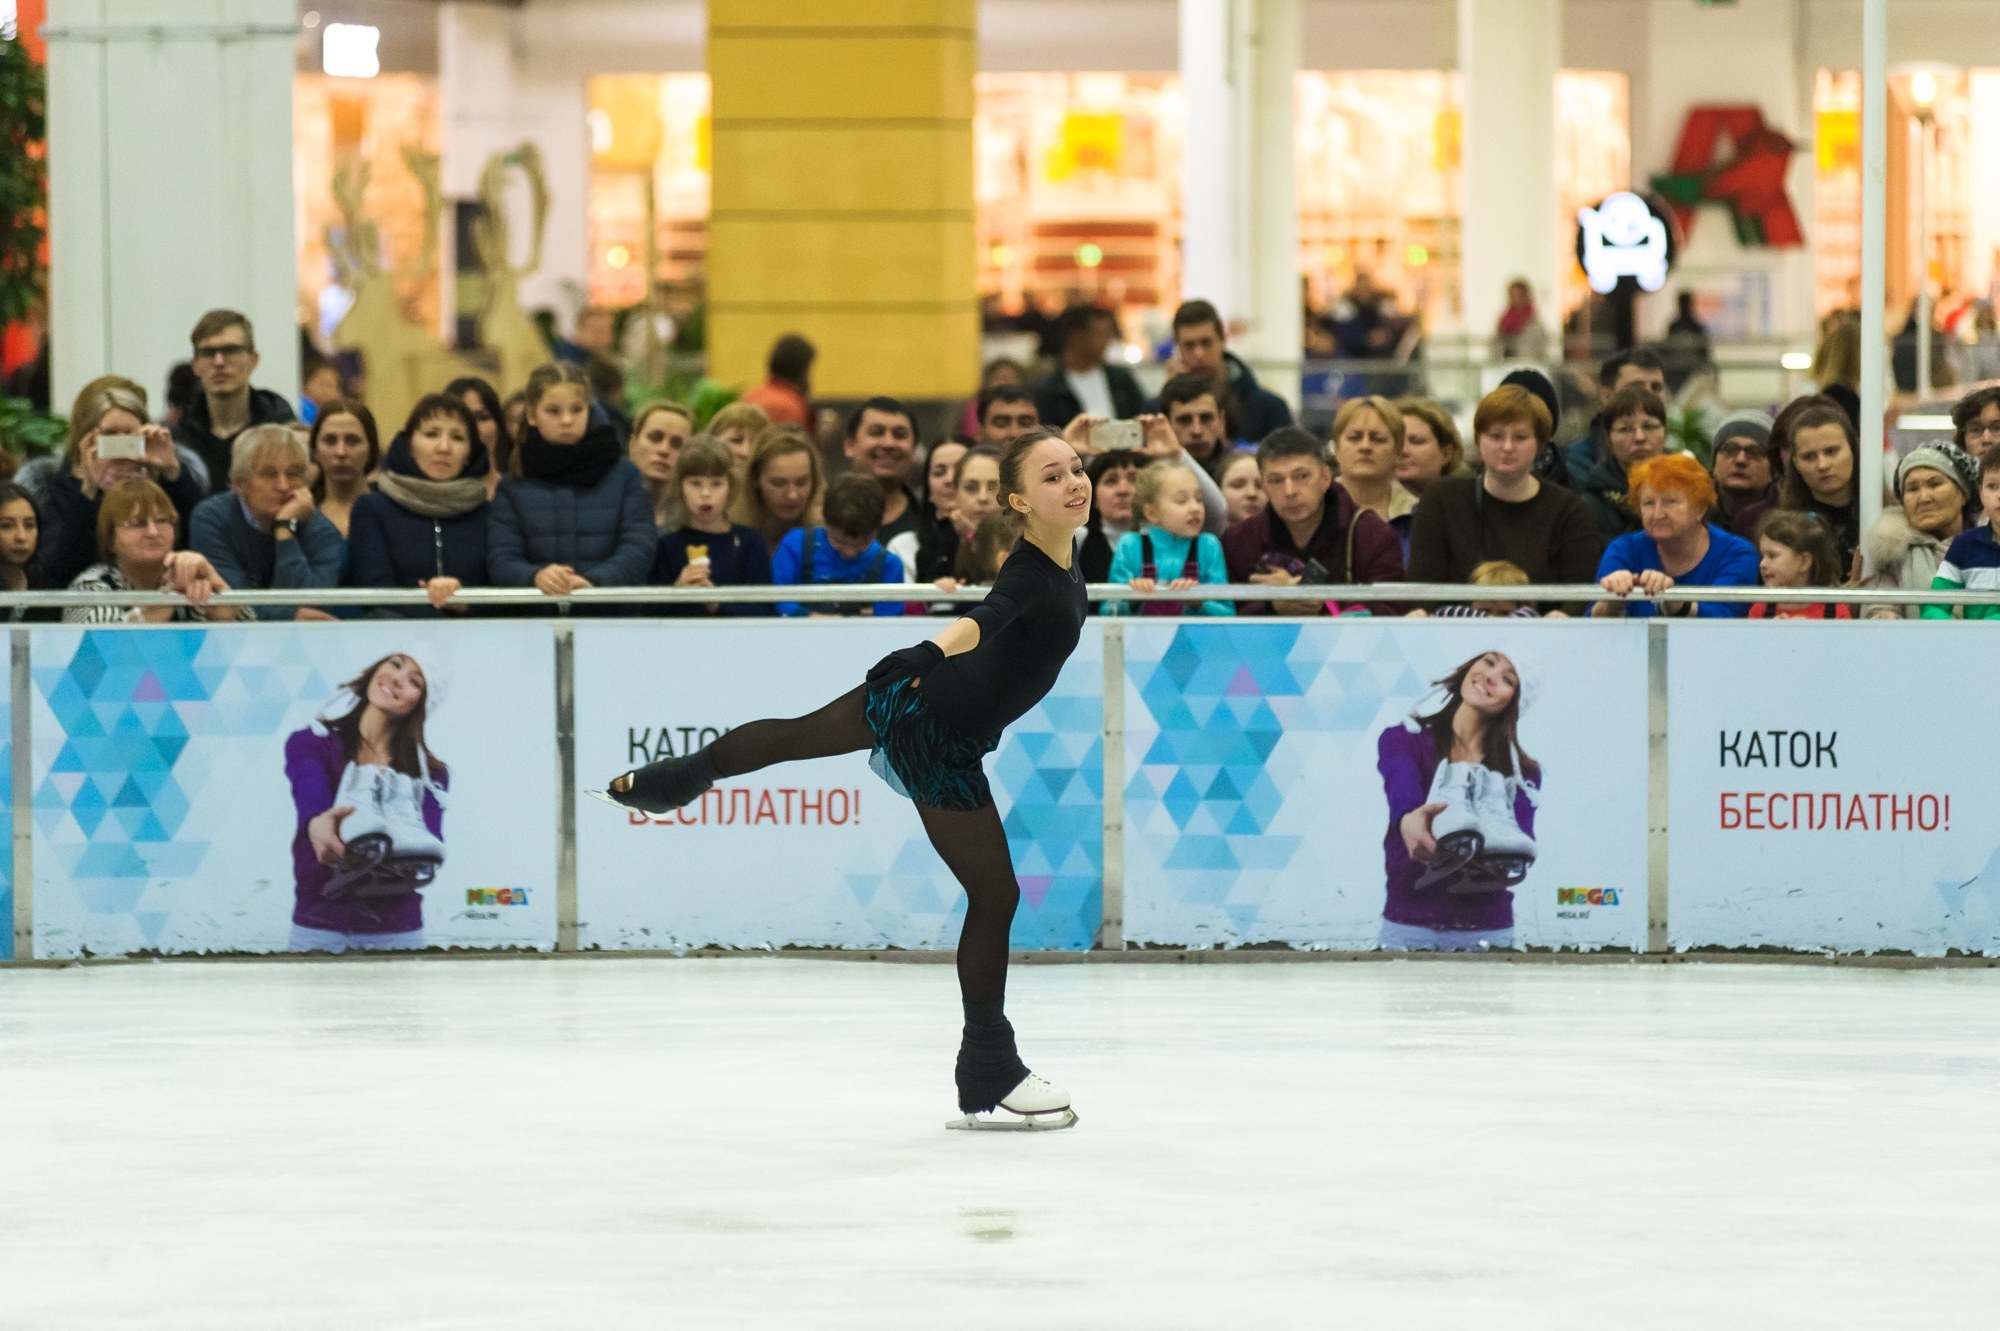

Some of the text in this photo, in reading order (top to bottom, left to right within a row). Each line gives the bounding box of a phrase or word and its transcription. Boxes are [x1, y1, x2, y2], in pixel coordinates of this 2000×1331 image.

[628, 727, 731, 764] КАТ
[1720, 730, 1838, 768] КАТОК
[628, 788, 861, 826] ПЛАТНО!
[1720, 792, 1950, 832] БЕСПЛАТНО!
